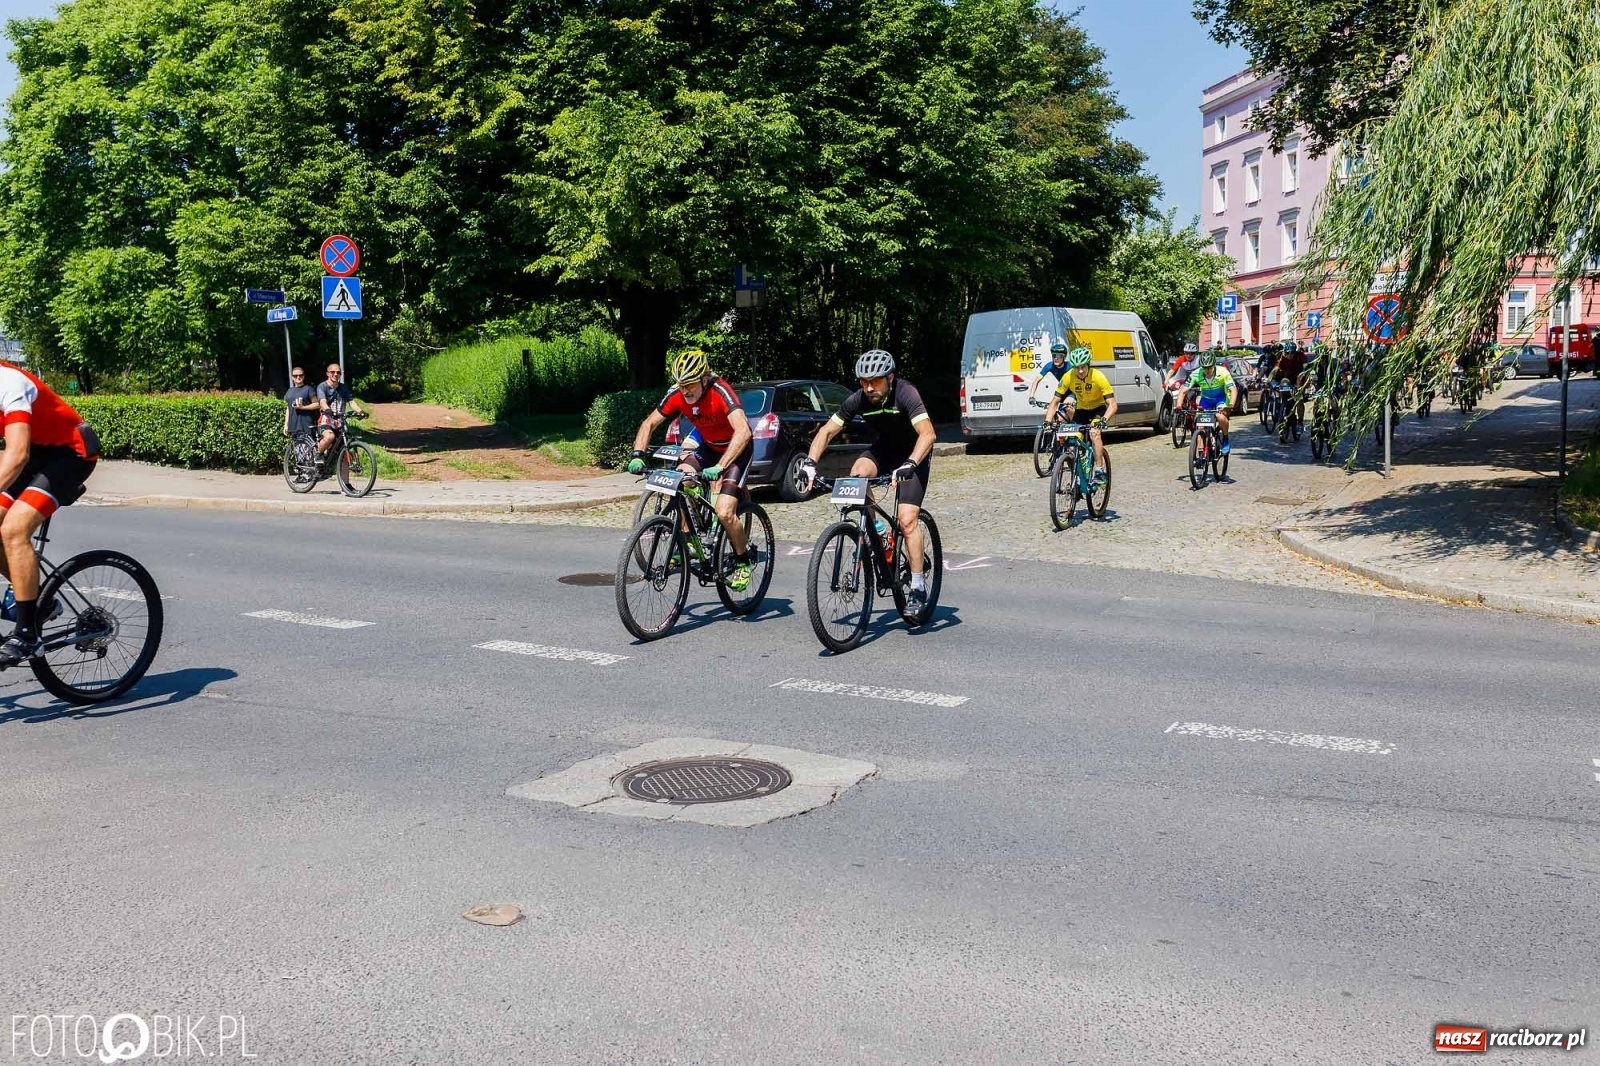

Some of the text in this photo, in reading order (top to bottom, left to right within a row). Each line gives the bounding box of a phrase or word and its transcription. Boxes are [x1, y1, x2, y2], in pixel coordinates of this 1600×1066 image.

[1020, 337, 1042, 346] OUT
[984, 349, 1007, 358] InPost
[1020, 362, 1043, 370] BOX
[654, 475, 674, 486] 1405
[838, 486, 860, 496] 2021
